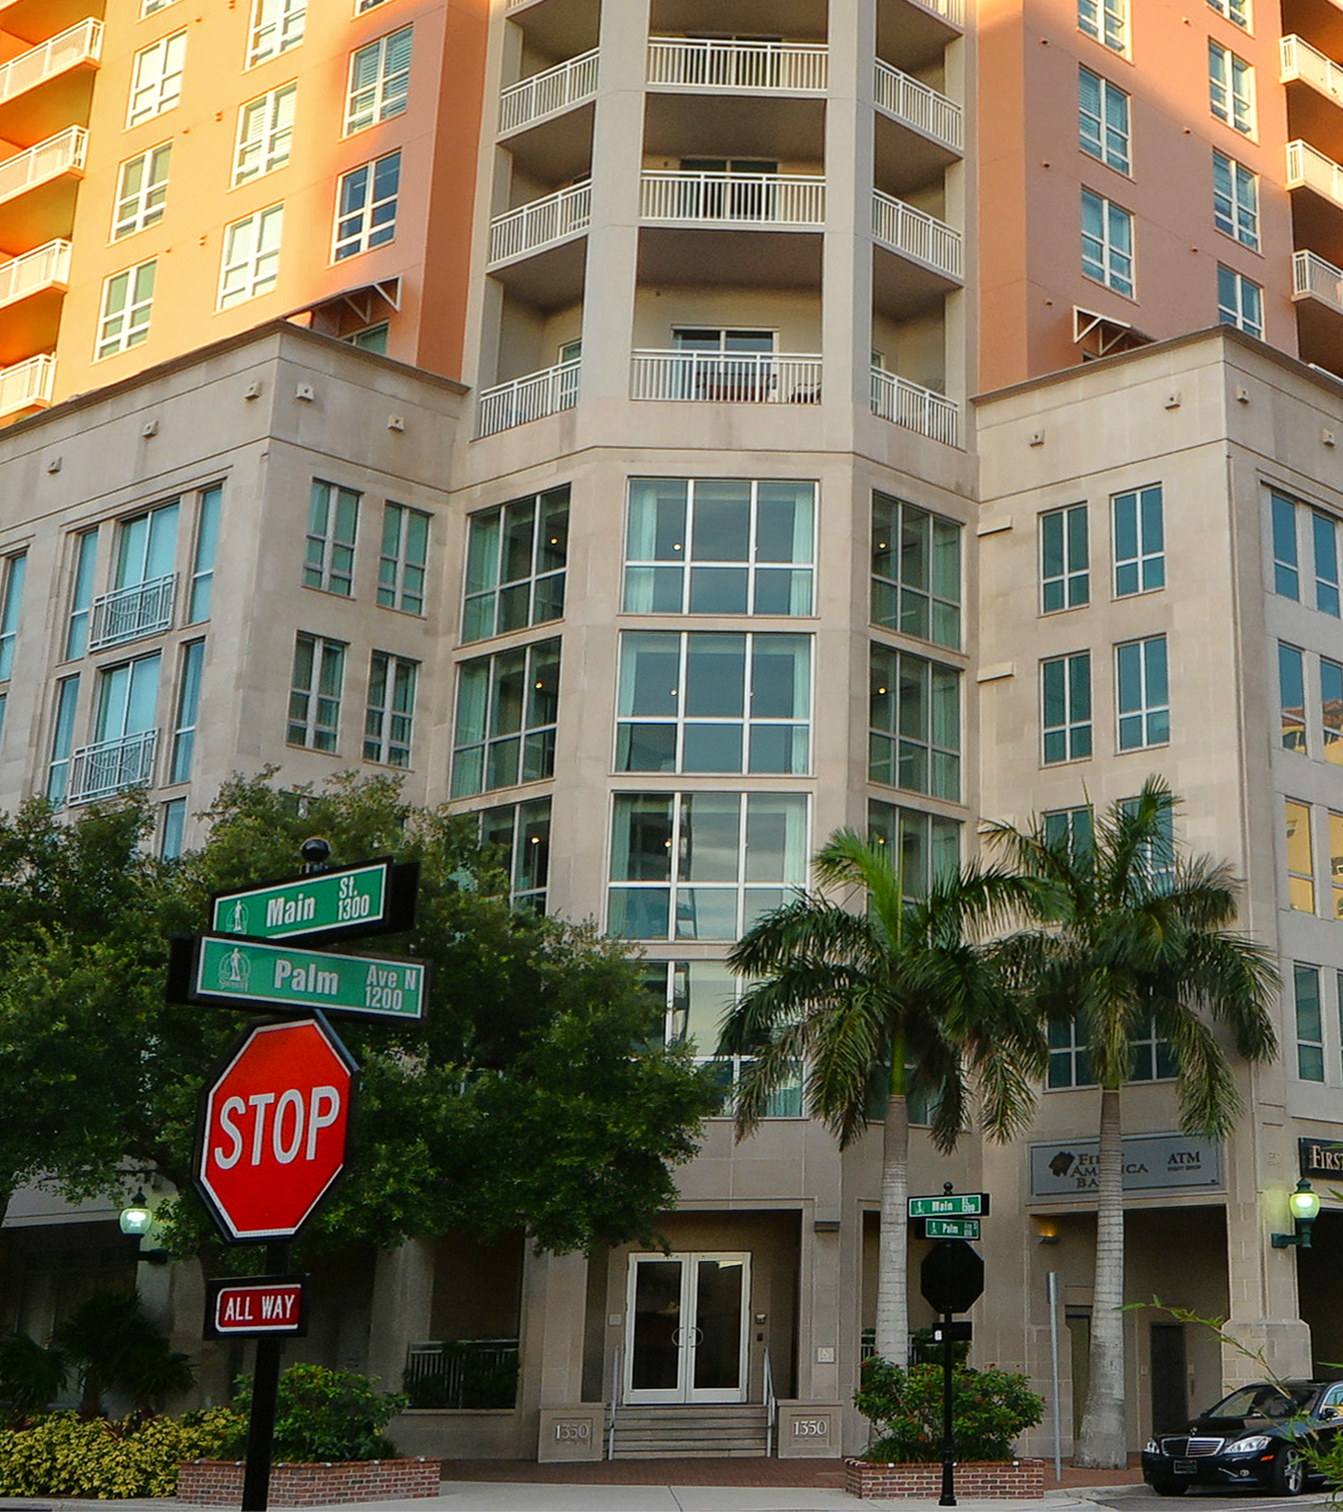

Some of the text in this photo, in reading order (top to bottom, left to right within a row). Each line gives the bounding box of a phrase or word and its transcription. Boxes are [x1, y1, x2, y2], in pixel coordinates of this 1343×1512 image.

[266, 876, 358, 927] Main St.
[338, 894, 370, 921] 1300
[274, 959, 338, 995] Palm
[366, 965, 397, 988] Ave
[405, 969, 416, 990] N
[365, 986, 402, 1010] 1200
[214, 1086, 340, 1169] STOP
[1167, 1151, 1201, 1164] ATM
[1070, 1164, 1148, 1177] AMICA
[932, 1200, 953, 1212] Main
[224, 1294, 295, 1321] ALL WAY
[555, 1423, 590, 1439] 1350
[794, 1420, 827, 1436] 1350
